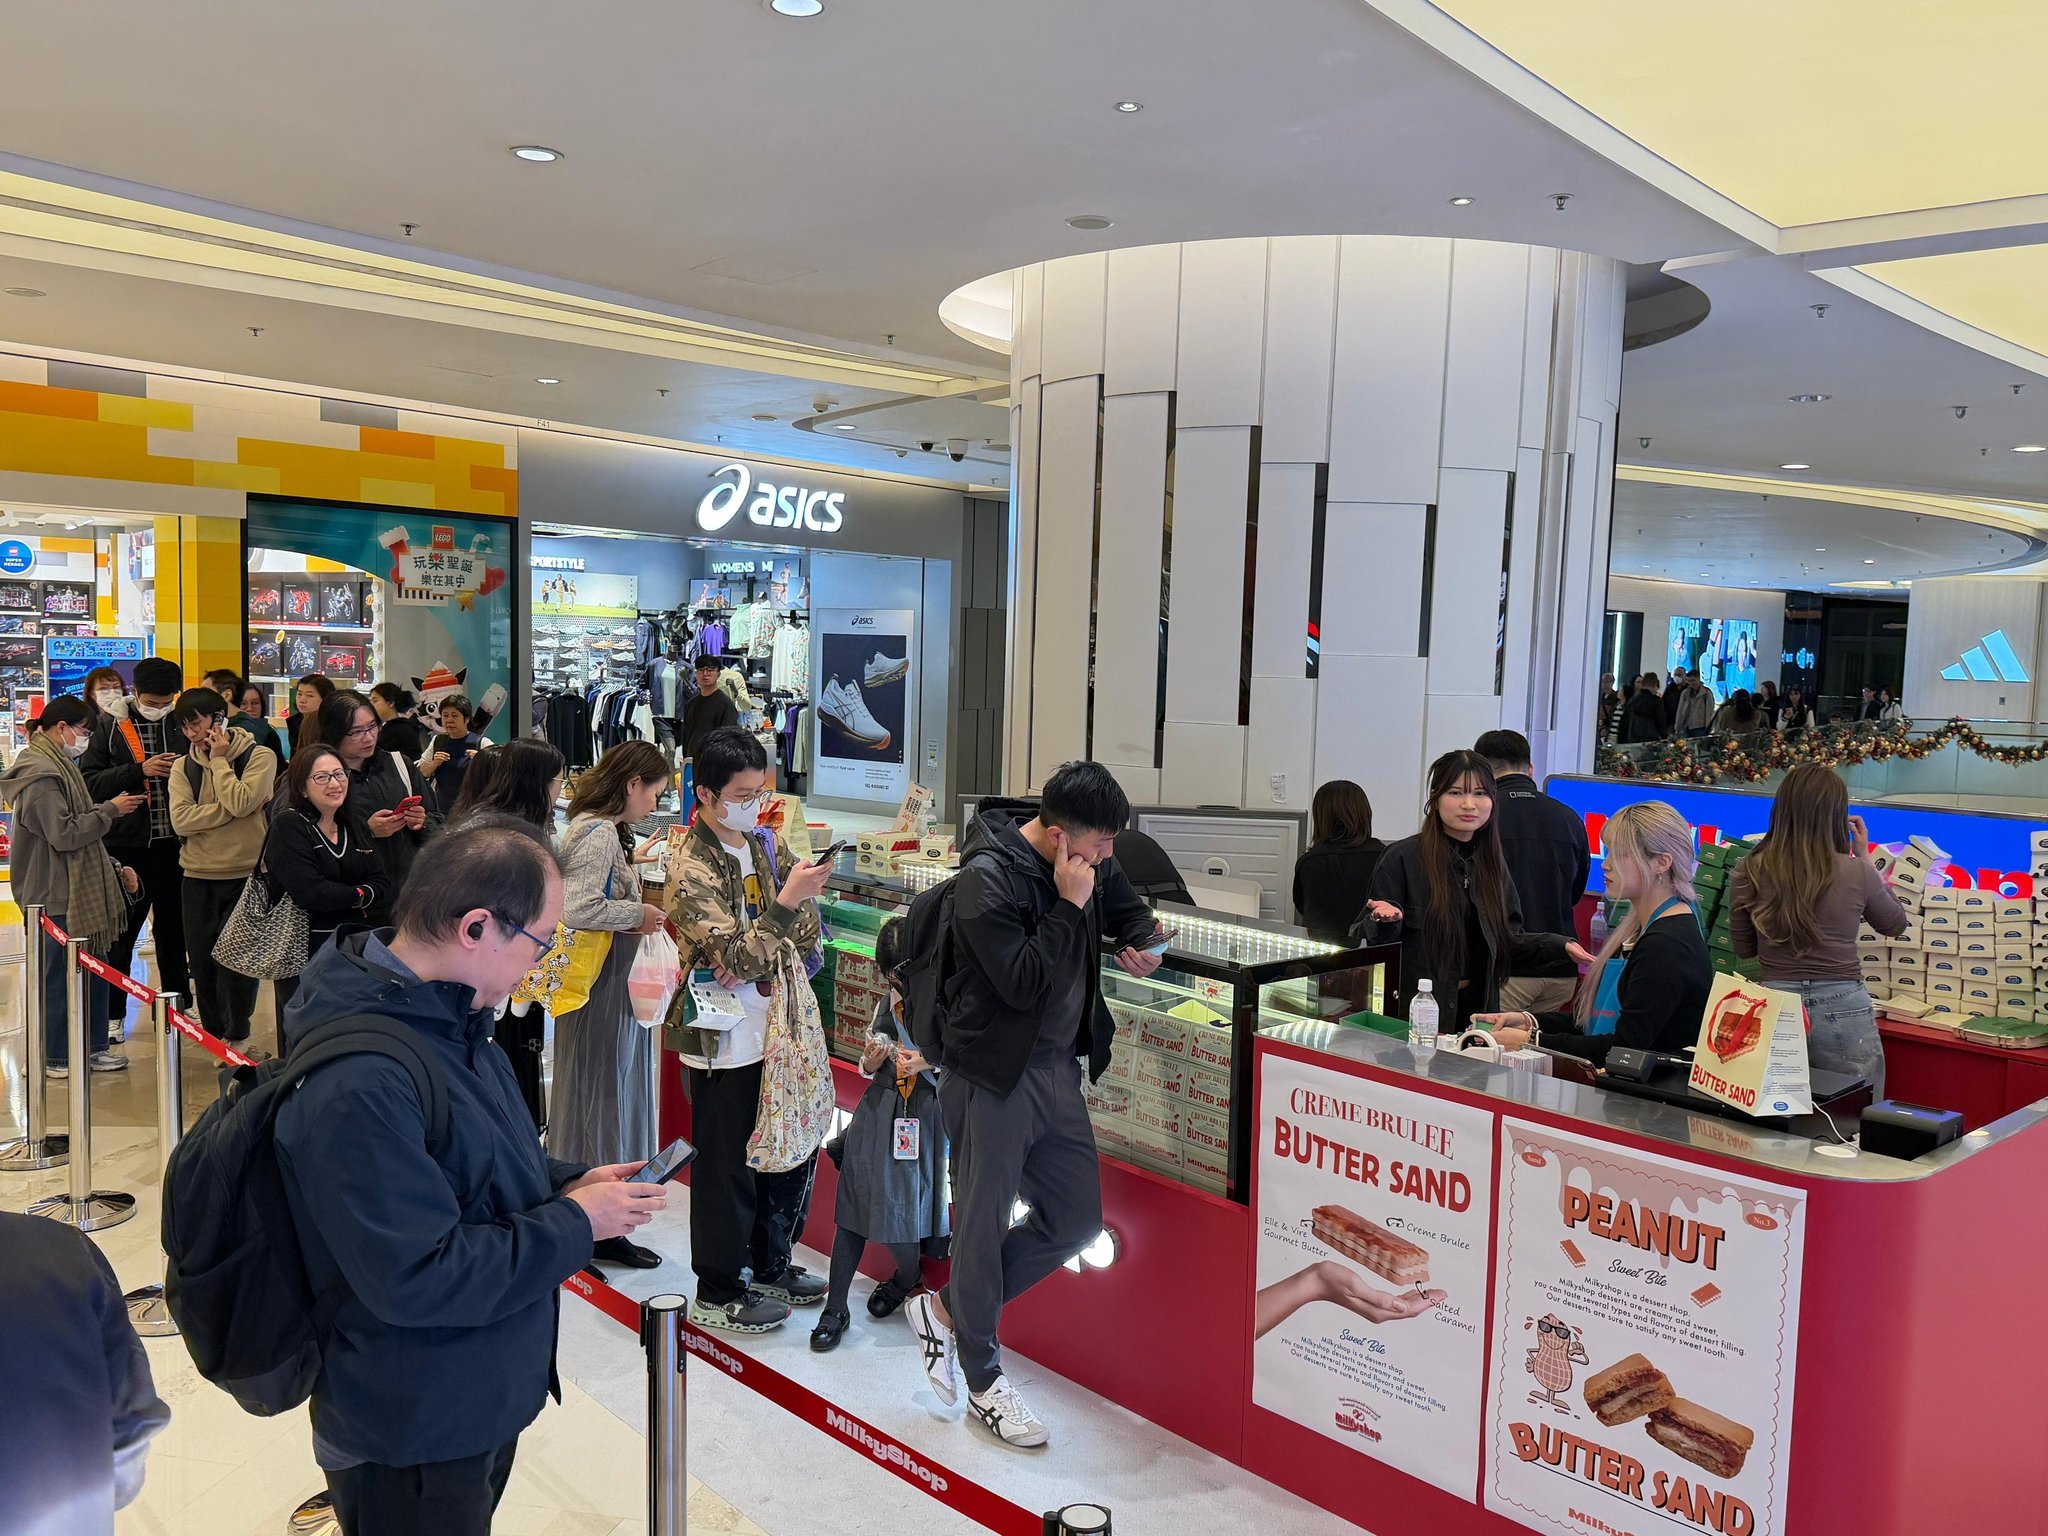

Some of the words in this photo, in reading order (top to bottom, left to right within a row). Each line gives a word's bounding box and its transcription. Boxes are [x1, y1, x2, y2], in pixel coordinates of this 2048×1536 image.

[748, 482, 846, 533] asics
[435, 534, 451, 542] LEGO
[712, 561, 755, 574] WOMENS
[62, 661, 88, 672] Disney
[1140, 1031, 1165, 1048] BUTTER
[1166, 1040, 1185, 1053] SAND
[1191, 1045, 1217, 1063] BUTTER
[1217, 1055, 1232, 1069] SAN
[1137, 1070, 1162, 1087] BUTTER
[1163, 1079, 1181, 1093] SAND
[1691, 1063, 1728, 1096] BUTTER
[1728, 1084, 1756, 1108] SAND
[1086, 1093, 1111, 1111] BUTTER
[1111, 1102, 1128, 1116] SAND
[1188, 1086, 1214, 1105] BUTTER
[1215, 1096, 1231, 1110] SAN
[1135, 1109, 1160, 1127] BUTTER
[1161, 1119, 1179, 1134] SAND
[1290, 1087, 1363, 1124] CREME
[1365, 1107, 1455, 1161] BRULEE
[1186, 1126, 1212, 1145] BUTTER
[1213, 1135, 1228, 1150] SAN
[1274, 1116, 1381, 1188] BUTTER
[1389, 1160, 1472, 1213] SAND
[1264, 1216, 1279, 1228] Elle
[1281, 1222, 1288, 1231] &
[1291, 1226, 1308, 1238] Vire
[1563, 1184, 1726, 1271] PEANUT
[1753, 1216, 1771, 1227] No.3
[1263, 1228, 1299, 1247] Gourmet
[1301, 1241, 1329, 1257] Butter
[1406, 1223, 1437, 1240] Creme
[1440, 1233, 1470, 1251] Brulee
[1607, 1258, 1643, 1279] Sweet
[1644, 1269, 1668, 1287] Bite
[1429, 1298, 1461, 1317] Salted
[1558, 1277, 1596, 1296] Milkyshop
[1597, 1291, 1627, 1306] desserts
[1629, 1302, 1642, 1312] are
[1644, 1308, 1673, 1323] creamy
[1675, 1316, 1691, 1328] and
[1693, 1323, 1719, 1338] sweet,
[1584, 1276, 1622, 1296] Milkyshop
[1639, 1294, 1667, 1310] dessert
[1670, 1304, 1691, 1318] shop.
[1434, 1312, 1476, 1334] Caramel
[1533, 1280, 1547, 1290] you
[1549, 1285, 1562, 1294] can
[1564, 1290, 1582, 1301] taste
[1583, 1296, 1609, 1310] several
[1611, 1305, 1631, 1318] types
[1633, 1313, 1648, 1324] and
[1650, 1317, 1677, 1333] flavors
[1689, 1331, 1718, 1346] dessert
[1721, 1340, 1747, 1356] filling.
[1546, 1292, 1560, 1303] Our
[1562, 1298, 1591, 1314] desserts
[1593, 1309, 1606, 1319] are
[1608, 1315, 1624, 1325] sure
[1635, 1324, 1660, 1338] satisfy
[1662, 1333, 1677, 1344] any
[1679, 1338, 1702, 1351] sweet
[1704, 1345, 1728, 1360] tooth.
[1320, 1336, 1351, 1354] Milkyshop
[1365, 1354, 1387, 1368] dessert
[1339, 1328, 1367, 1347] Sweet
[1367, 1339, 1386, 1355] Bite
[1281, 1337, 1292, 1346] you
[1293, 1341, 1304, 1351] can
[1305, 1346, 1319, 1357] taste
[1320, 1354, 1341, 1367] several
[1342, 1361, 1358, 1374] types
[1360, 1369, 1372, 1379] and
[1373, 1373, 1394, 1388] flavors
[1404, 1388, 1427, 1403] dessert
[1300, 1336, 1330, 1354] Milkyshop
[1332, 1349, 1355, 1364] desserts
[1357, 1360, 1368, 1369] are
[1369, 1365, 1391, 1380] creamy
[1393, 1374, 1405, 1384] and
[1290, 1348, 1302, 1358] Our
[1304, 1354, 1327, 1369] desserts
[1328, 1365, 1338, 1374] are
[1340, 1370, 1353, 1380] sure
[1361, 1379, 1381, 1393] satisfy
[1382, 1388, 1393, 1399] any
[1395, 1394, 1413, 1406] sweet
[826, 1407, 949, 1493] MilkyShop
[1508, 1422, 1646, 1502] BUTTER
[1651, 1470, 1755, 1536] SAND
